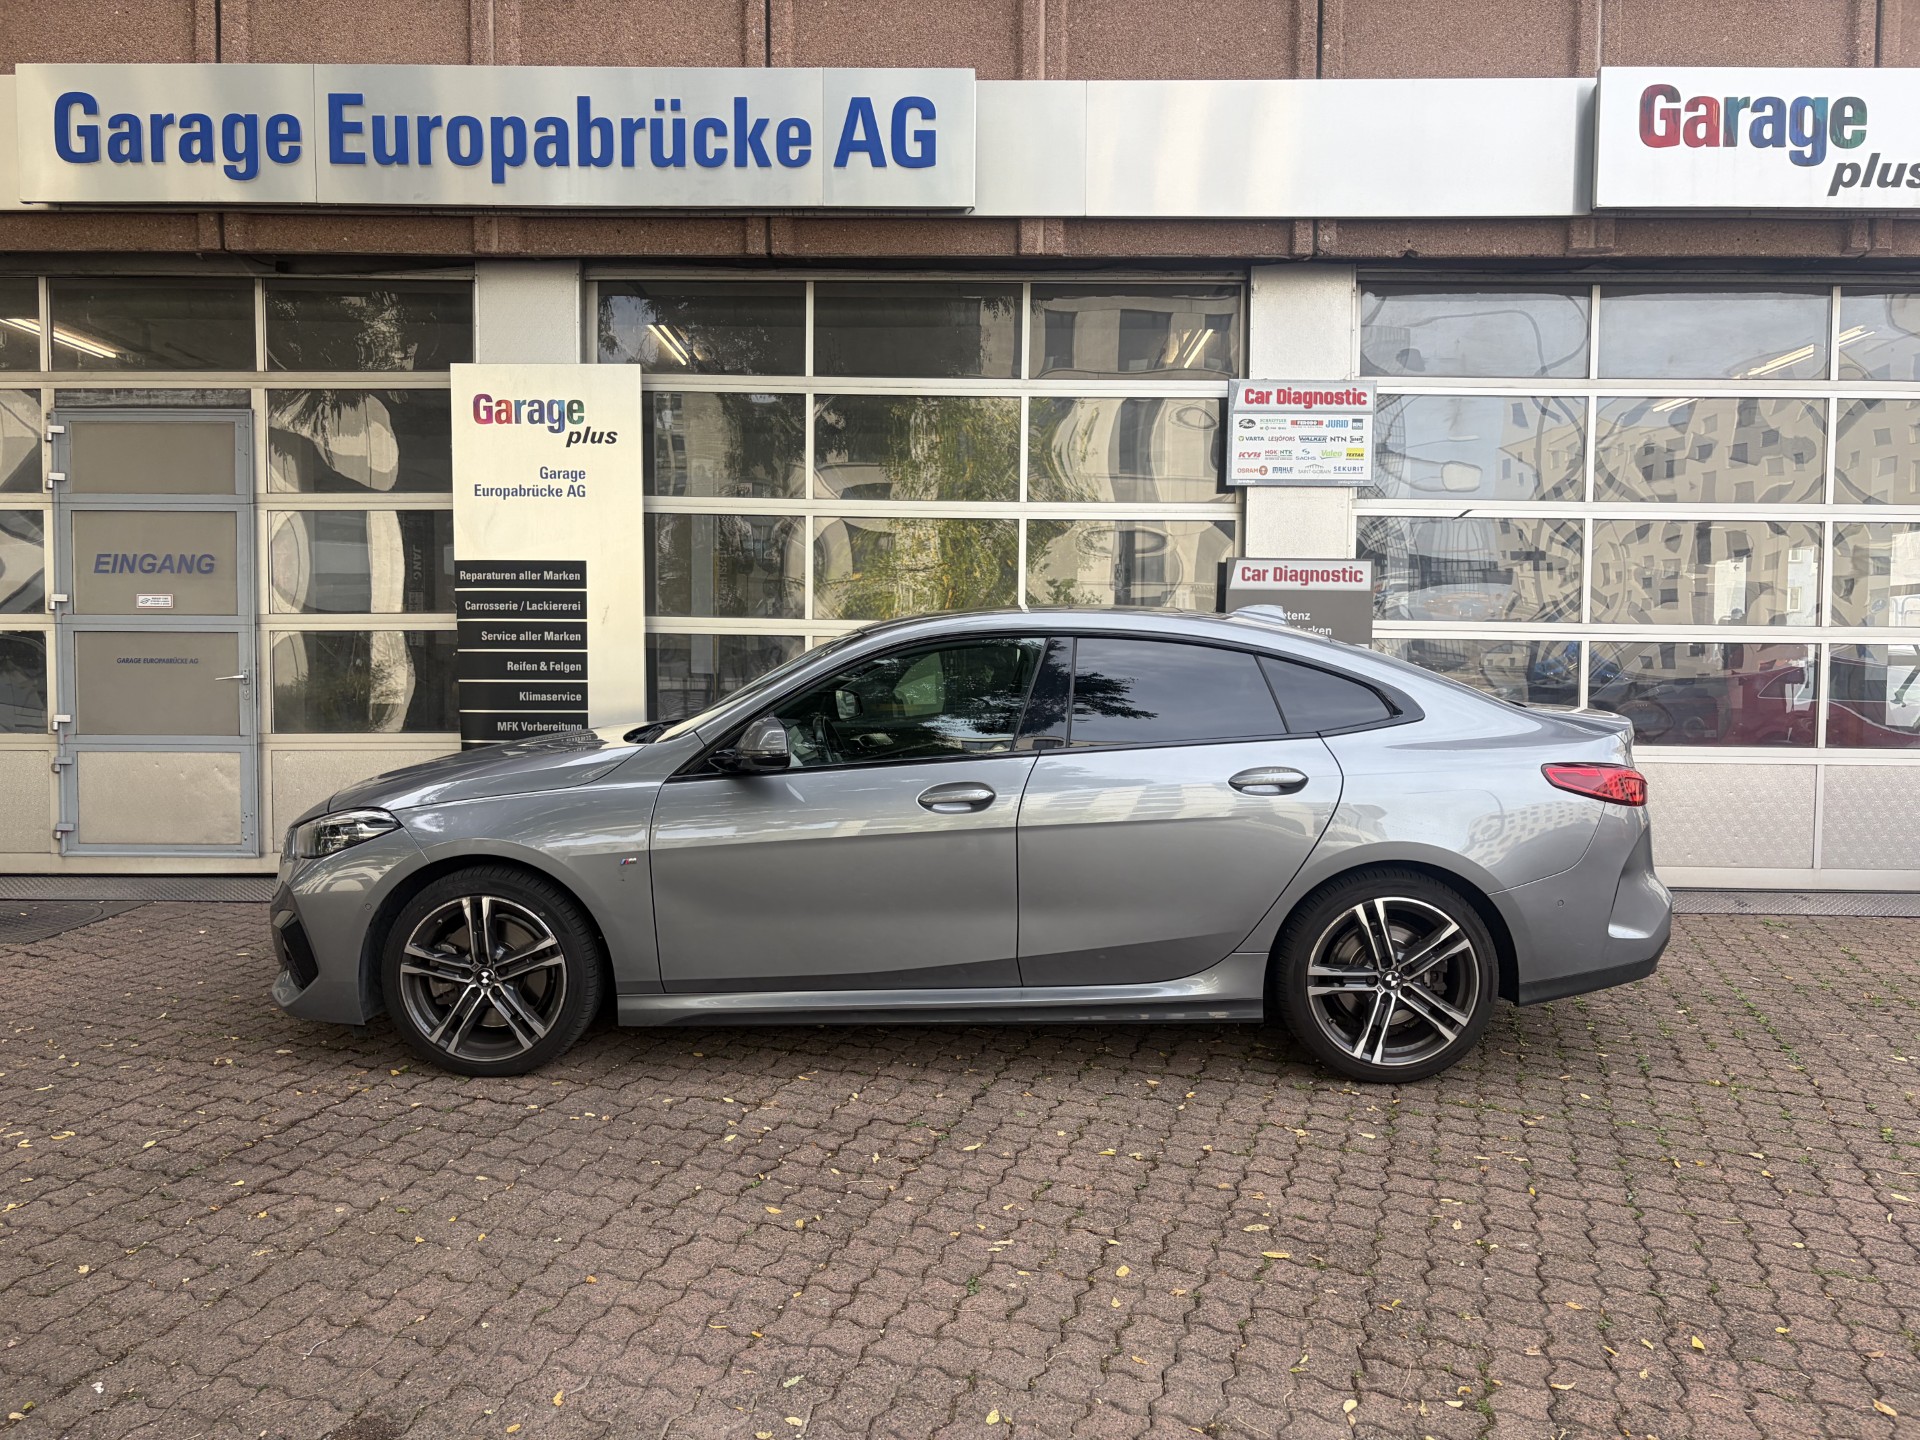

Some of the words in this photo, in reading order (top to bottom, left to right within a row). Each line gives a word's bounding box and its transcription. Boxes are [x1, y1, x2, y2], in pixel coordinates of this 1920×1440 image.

[1638, 83, 1868, 167] Garage
[53, 91, 302, 181] Garage
[328, 92, 811, 184] Europabrücke
[833, 96, 937, 169] AG
[1244, 388, 1273, 405] Car
[1276, 386, 1368, 410] Diagnostic
[472, 393, 585, 433] Garage
[1325, 419, 1349, 429] JURID
[565, 426, 618, 448] plus
[1321, 450, 1343, 458] Valeo
[539, 466, 586, 482] Garage
[1272, 466, 1294, 474] MAHLE
[474, 484, 563, 500] Europabrücke
[567, 485, 586, 498] AG
[93, 553, 216, 575] EINGANG
[459, 570, 517, 582] Reparaturen
[518, 571, 541, 581] aller
[543, 571, 581, 581] Marken
[1241, 566, 1269, 582] Car
[1273, 565, 1364, 586] Diagnostic
[464, 601, 518, 611] Carrosserie
[519, 601, 525, 611] /
[526, 601, 581, 611] Lackiererei
[481, 631, 517, 641] Service
[519, 631, 542, 641] aller
[544, 631, 581, 641] Marken
[143, 656, 188, 665] EUROPABRÜCKE
[507, 662, 538, 671] Reifen
[539, 662, 548, 671] &
[549, 662, 582, 673] Felgen
[519, 692, 582, 701] Klimaservice
[497, 722, 519, 731] MFK
[521, 722, 582, 732] Vorbereitung
